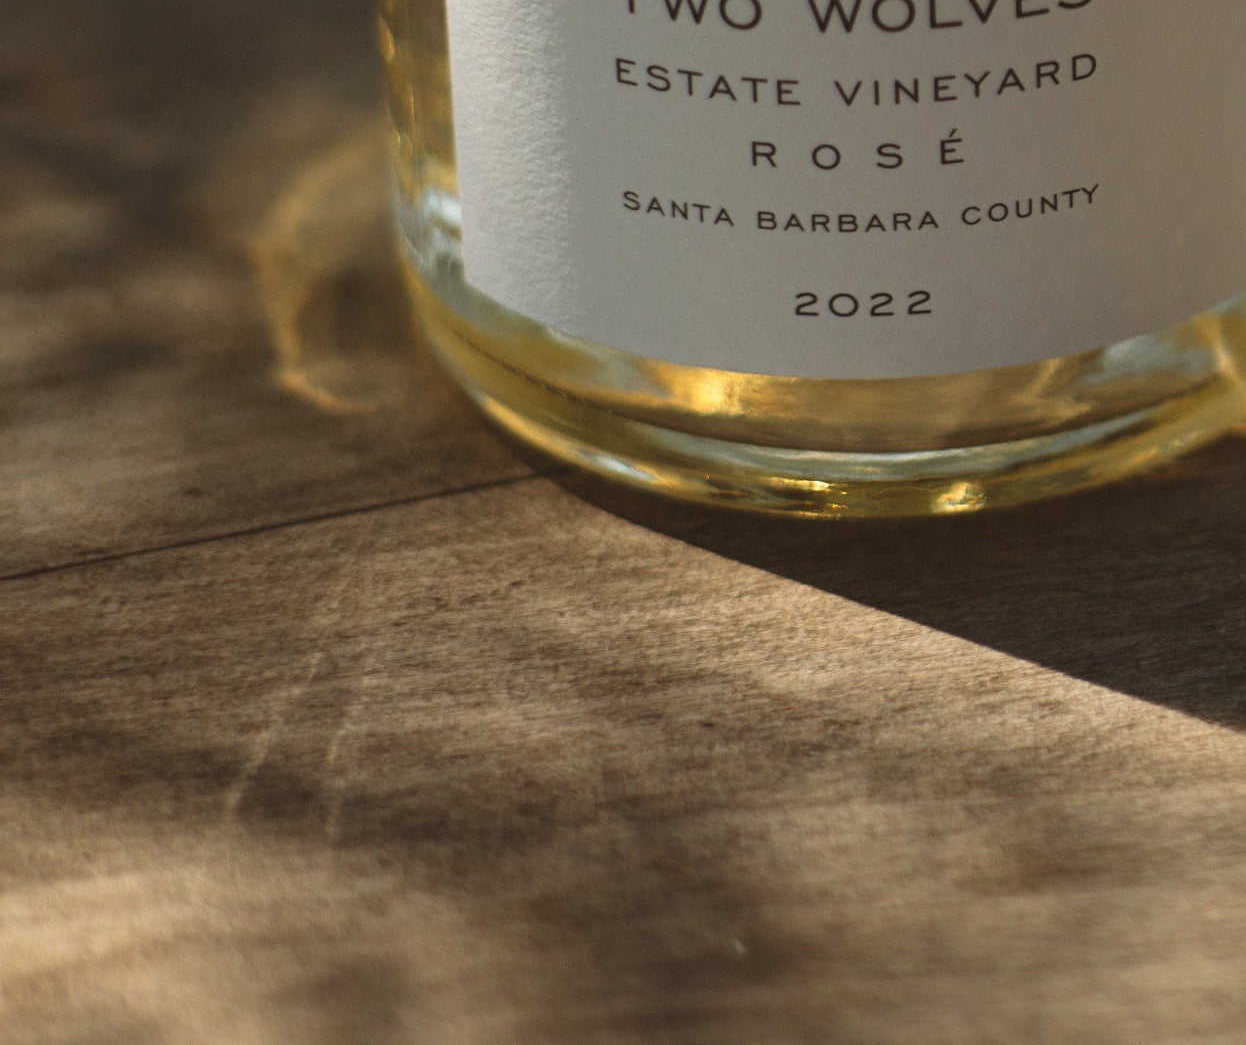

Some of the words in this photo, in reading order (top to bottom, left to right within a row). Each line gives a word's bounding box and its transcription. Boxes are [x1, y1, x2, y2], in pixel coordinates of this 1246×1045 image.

[614, 57, 802, 107] ESTATE
[833, 53, 1098, 107] VINEYARD
[750, 128, 965, 171] ROSÉ
[622, 190, 735, 228] SANTA
[756, 210, 940, 234] BARBARA
[960, 183, 1100, 226] COUNTY
[794, 290, 933, 318] 2022
